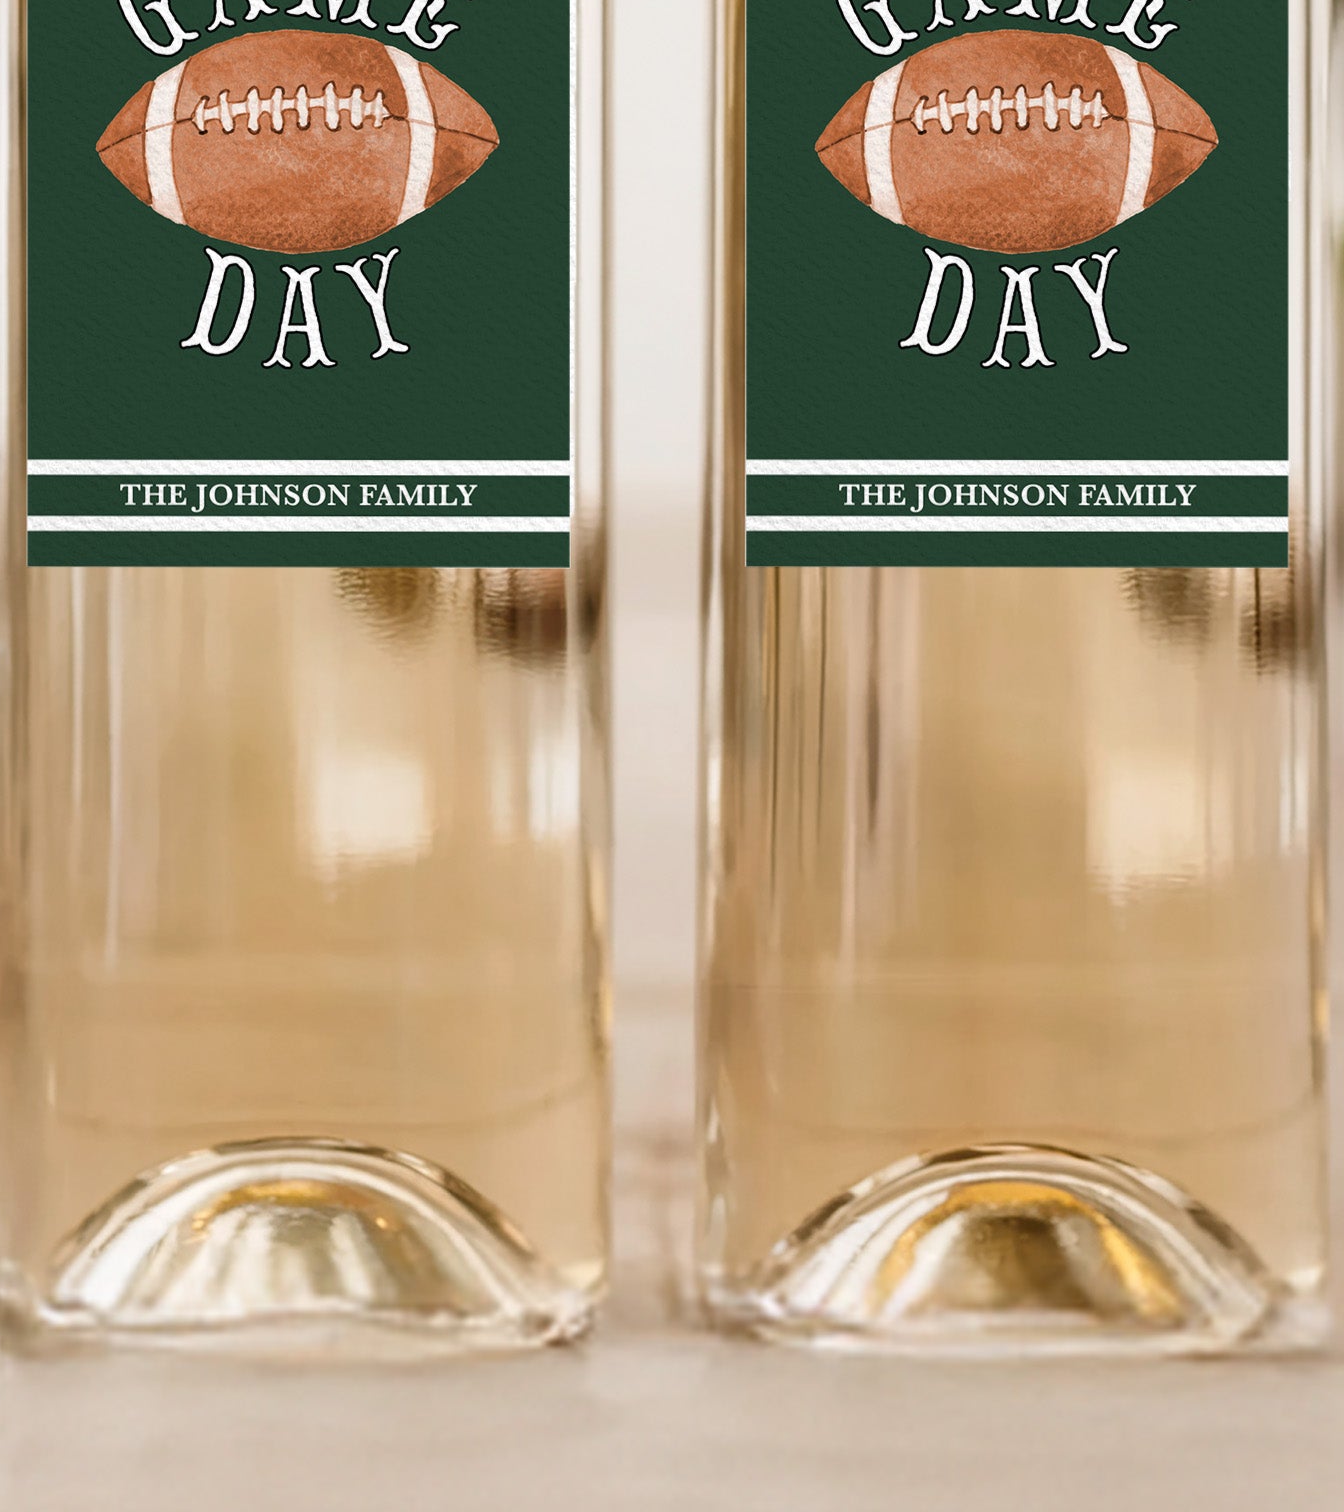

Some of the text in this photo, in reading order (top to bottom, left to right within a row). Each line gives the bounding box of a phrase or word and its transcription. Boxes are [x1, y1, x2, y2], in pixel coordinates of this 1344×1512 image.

[179, 246, 410, 369] DAY
[898, 246, 1129, 369] DAY
[119, 483, 478, 513] THE JOHNSON FAMILY
[838, 483, 1197, 513] THE JOHNSON FAMILY
